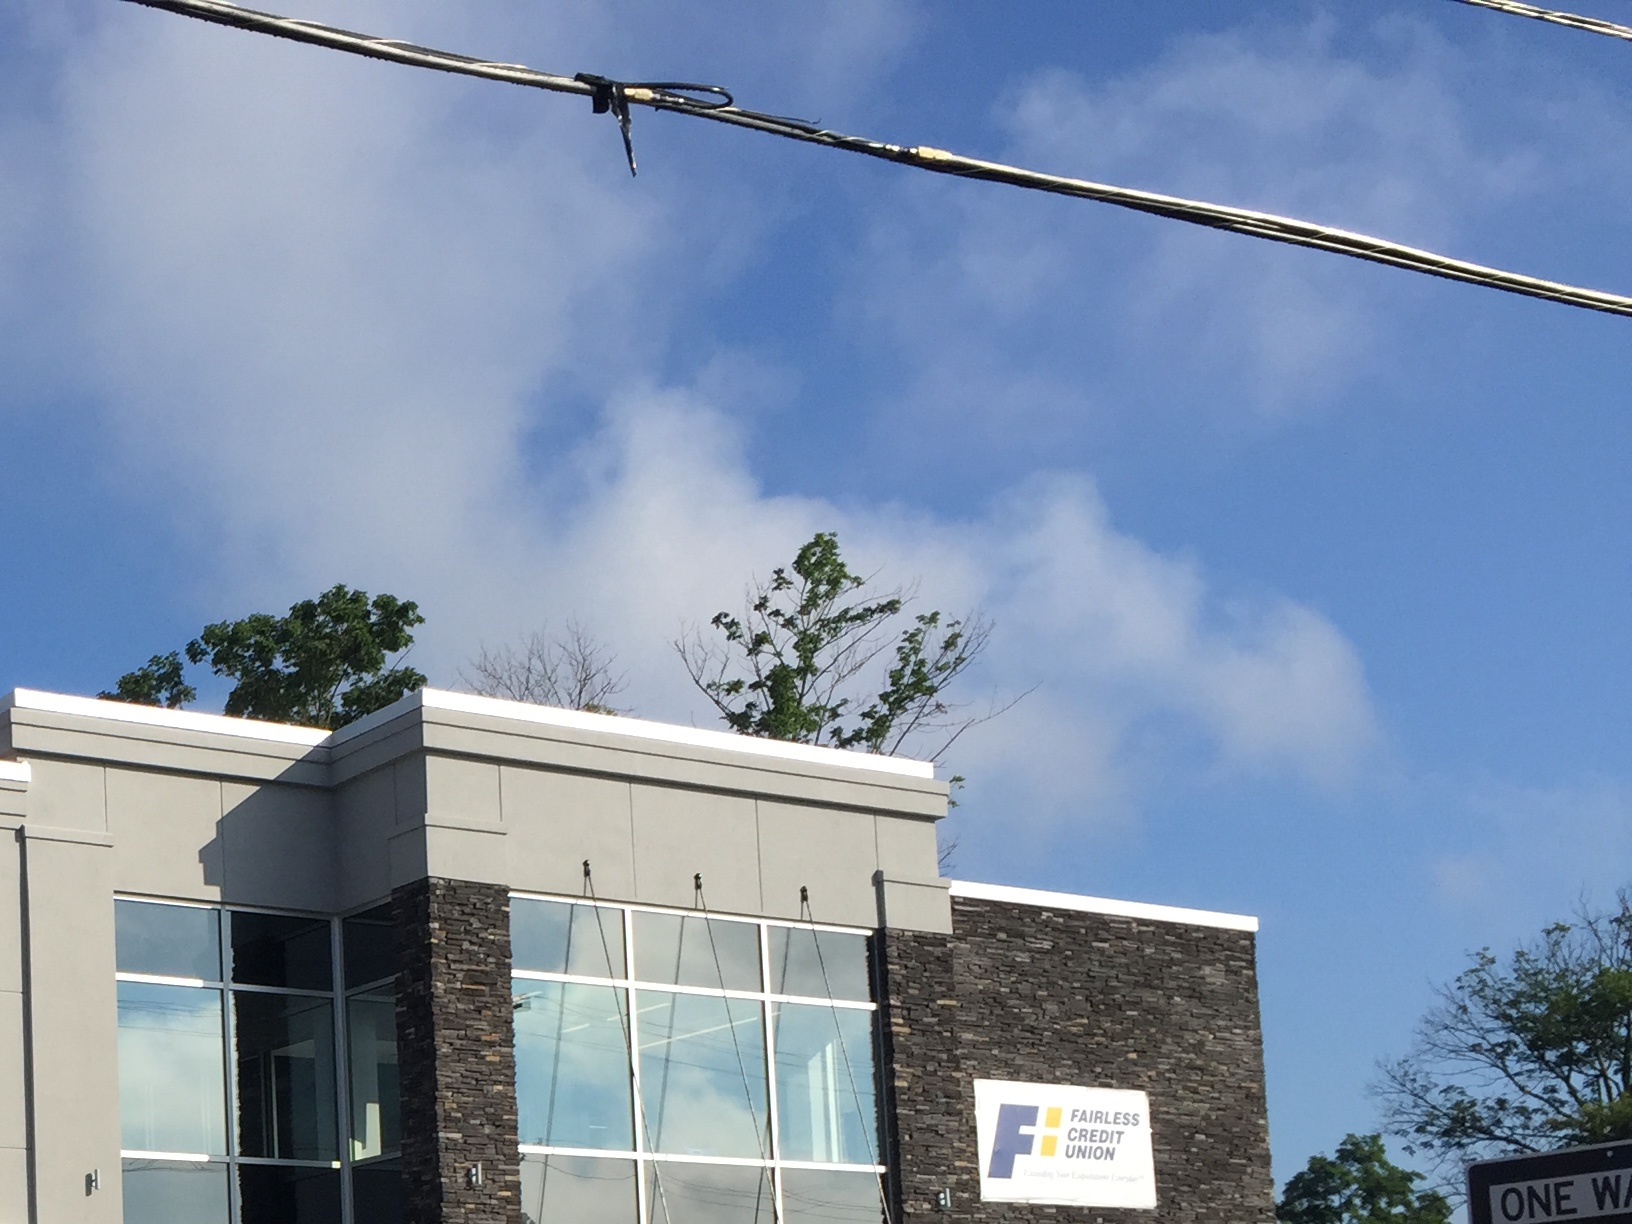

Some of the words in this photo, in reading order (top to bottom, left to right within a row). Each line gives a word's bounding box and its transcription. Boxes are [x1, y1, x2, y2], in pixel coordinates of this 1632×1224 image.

[1070, 1109, 1140, 1127] FAIRLESS
[1067, 1127, 1125, 1144] CREDIT
[1065, 1144, 1116, 1161] UNION
[1500, 1180, 1578, 1221] ONE
